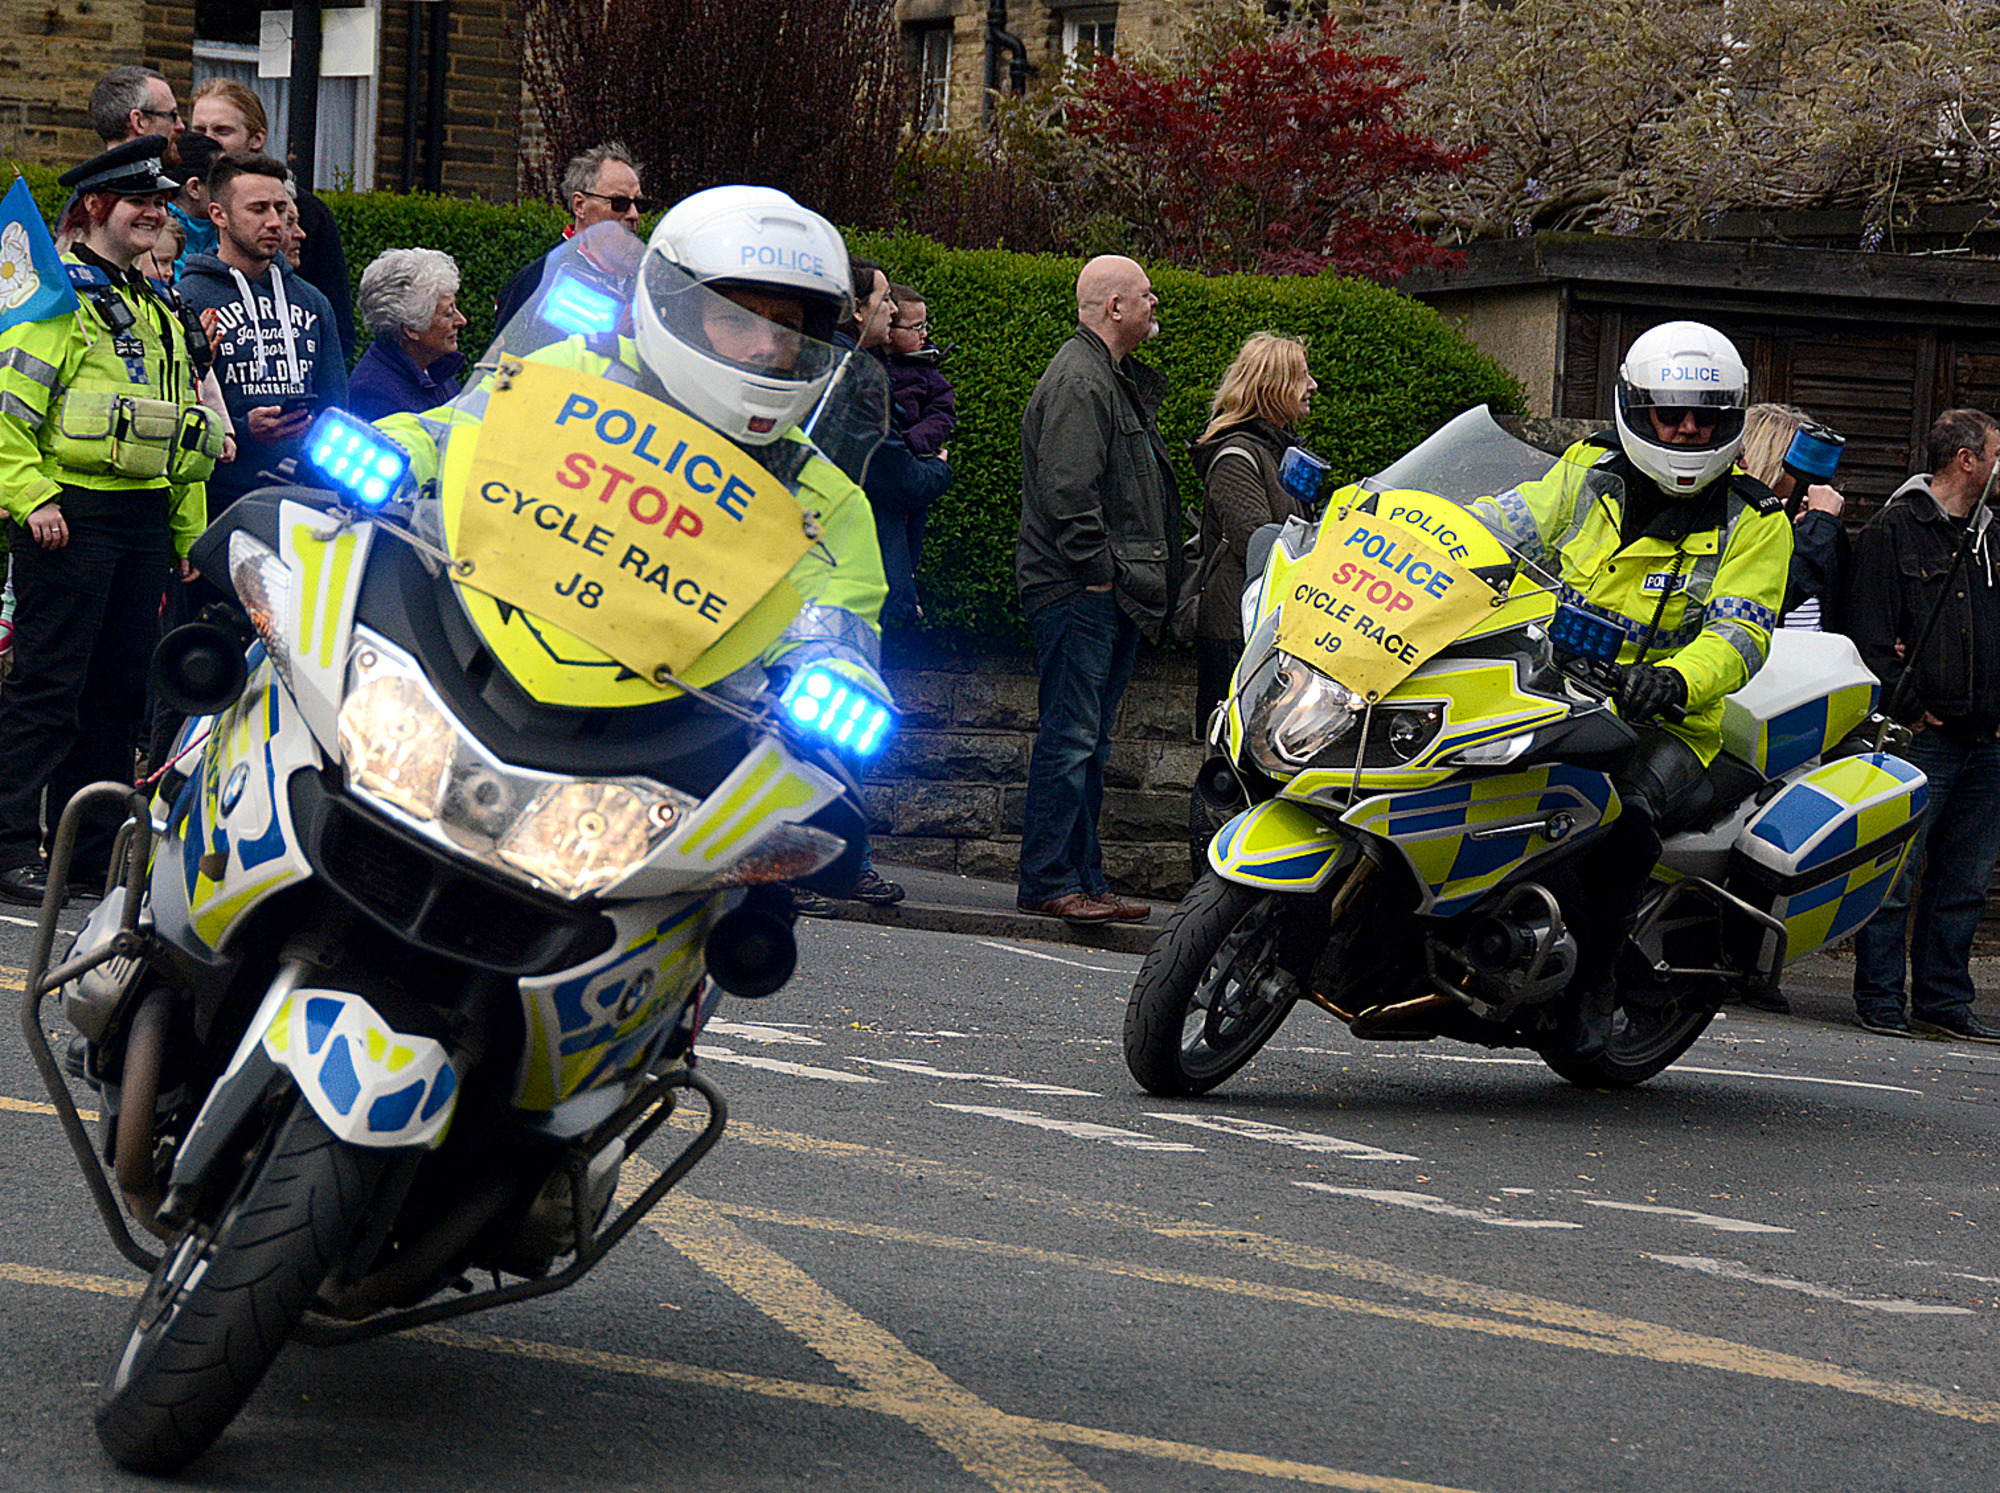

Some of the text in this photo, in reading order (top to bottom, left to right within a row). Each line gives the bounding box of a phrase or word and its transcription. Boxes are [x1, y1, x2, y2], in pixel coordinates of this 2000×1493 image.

[741, 246, 824, 277] POLICE
[216, 296, 317, 336] SUPRRY
[220, 342, 235, 356] 19
[236, 325, 301, 346] Jaanee
[224, 359, 314, 384] ATH.DP
[1661, 366, 1719, 382] POLICE
[555, 392, 757, 522] POLICE
[556, 452, 704, 539] STOP
[480, 481, 728, 624] CYCLE RACE
[1389, 507, 1469, 561] POLICE
[1343, 527, 1455, 600] POLICE
[554, 572, 604, 609] J8
[1332, 562, 1414, 613] STOP
[1646, 576, 1684, 590] POLCE
[1294, 584, 1420, 666] CYCLE RACE
[1314, 631, 1342, 653] J9
